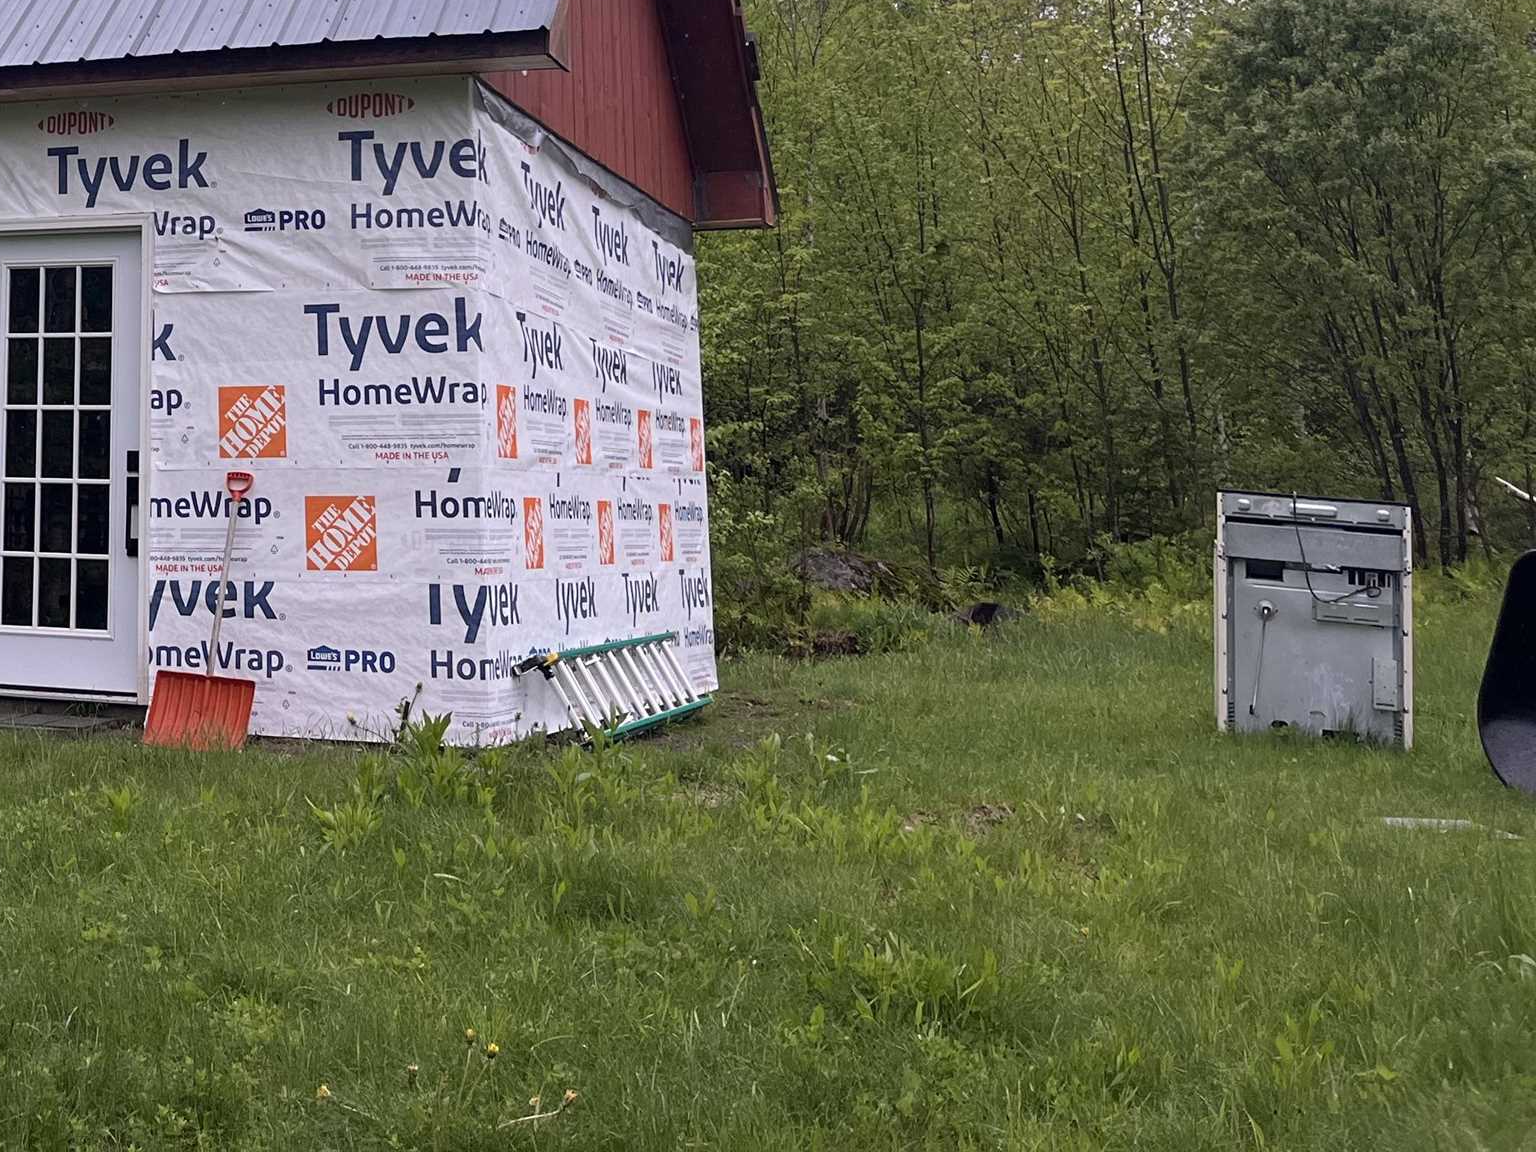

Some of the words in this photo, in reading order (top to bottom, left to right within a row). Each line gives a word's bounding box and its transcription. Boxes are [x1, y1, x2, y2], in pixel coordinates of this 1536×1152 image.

[47, 111, 106, 135] DUPONT
[337, 93, 405, 119] DUPONT
[48, 139, 209, 208] Tyvek
[339, 130, 488, 196] Tyvek
[279, 209, 326, 231] PRO
[521, 161, 565, 231] Tyvek
[592, 205, 629, 266] Tyvek
[652, 240, 684, 295] Tyvek
[304, 297, 483, 371] Tyvek
[516, 312, 563, 379] Tyvek
[219, 386, 286, 457] HOME
[319, 377, 487, 409] HomeWrap
[306, 497, 376, 569] HOME
[622, 572, 658, 628] Tyvek
[345, 650, 395, 674] PRO
